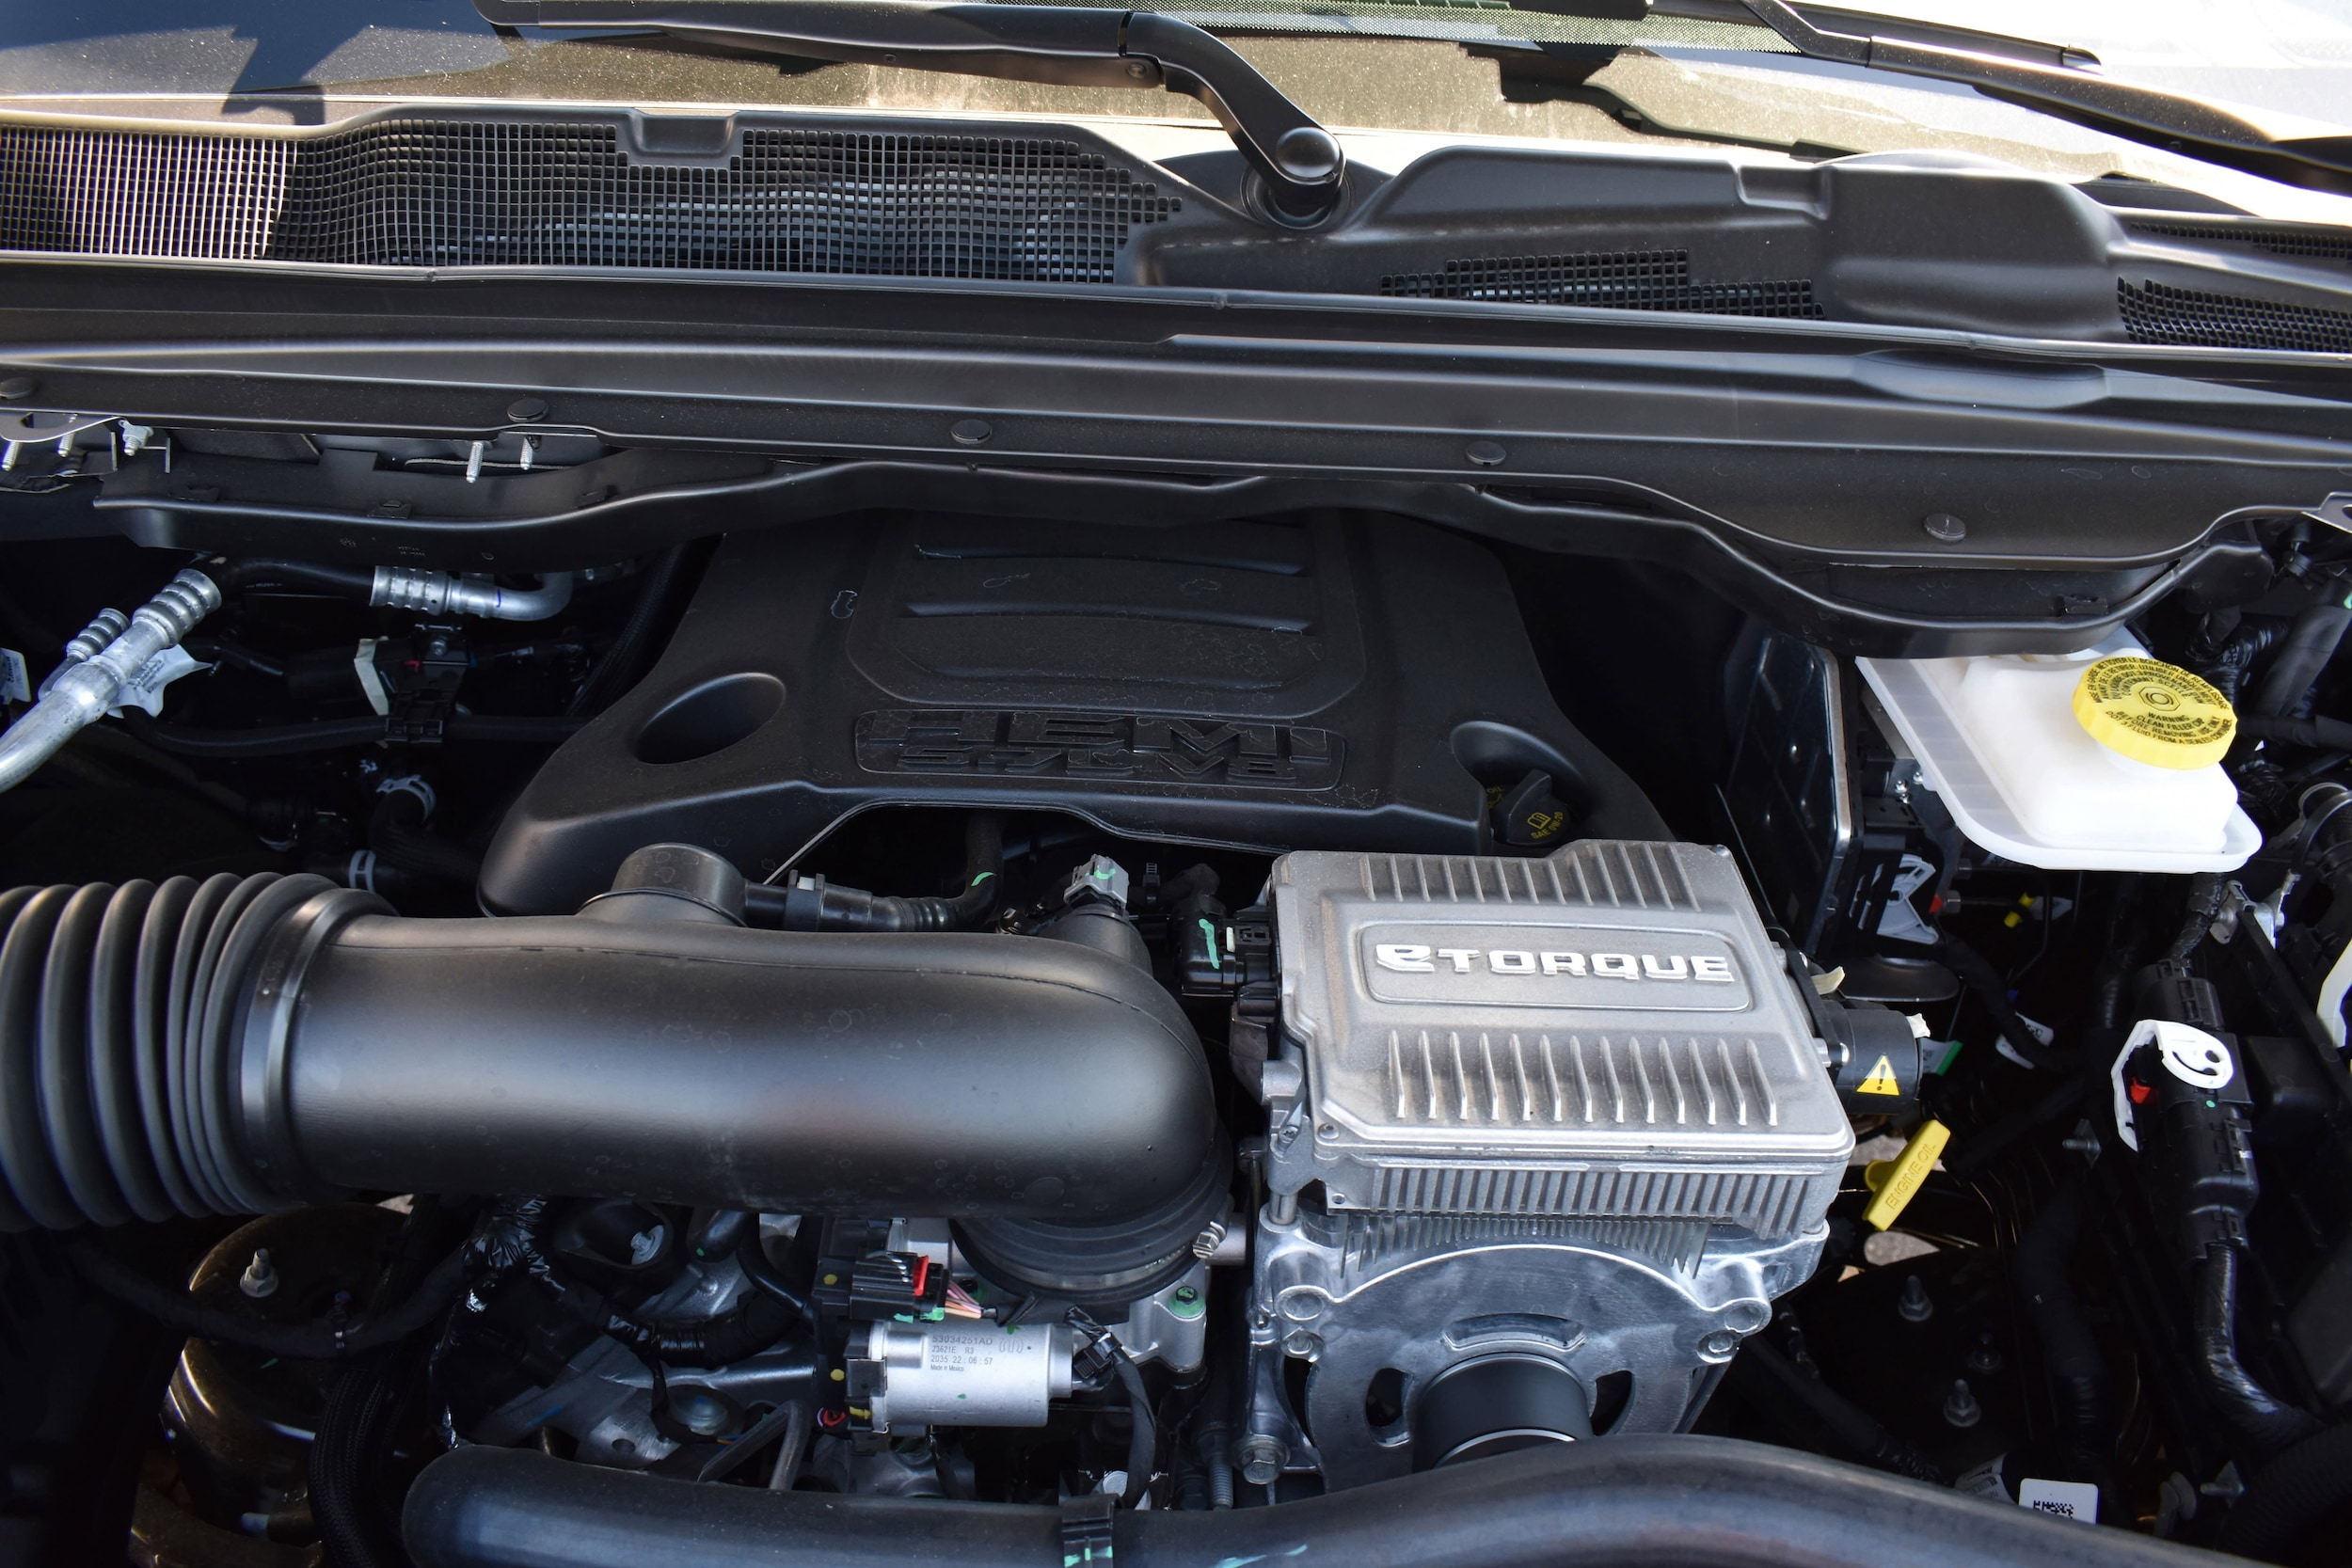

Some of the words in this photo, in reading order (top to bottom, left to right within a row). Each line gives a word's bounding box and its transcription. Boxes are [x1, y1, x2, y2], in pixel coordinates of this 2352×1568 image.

[2137, 663, 2174, 676] UTILISER
[2138, 657, 2179, 673] BOUCHON
[2180, 669, 2190, 677] DE
[2143, 670, 2192, 691] PROVENANT
[2117, 711, 2149, 730] BEFORE
[2137, 715, 2164, 729] CLEAN
[868, 709, 1332, 765] HEMI
[2127, 724, 2151, 736] FLUID
[2153, 734, 2177, 743] FROM
[1531, 828, 1550, 839] SAE
[1549, 812, 1564, 831] 0W-20
[1884, 1161, 1922, 1210] ENGINE
[1917, 1143, 1936, 1163] OIL
[930, 1354, 948, 1363] 2035
